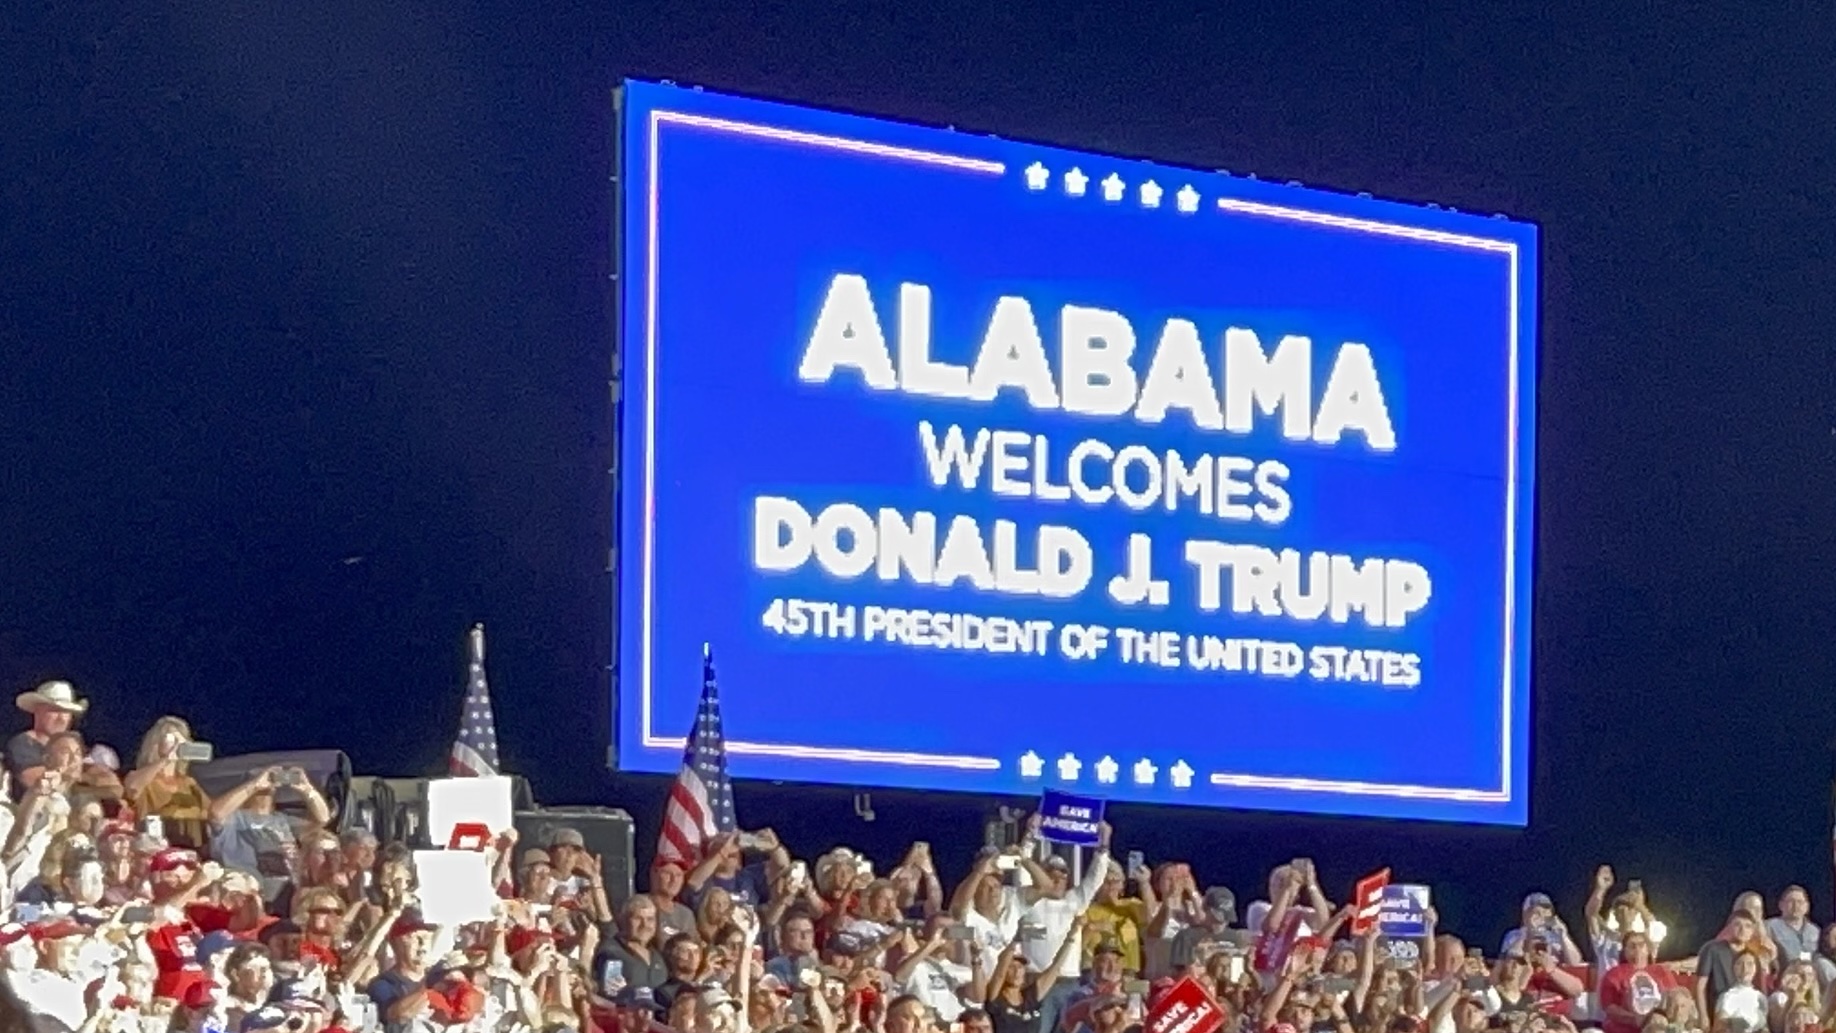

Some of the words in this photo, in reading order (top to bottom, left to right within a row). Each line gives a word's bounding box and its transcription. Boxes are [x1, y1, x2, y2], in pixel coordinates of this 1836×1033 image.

[798, 273, 1397, 452] ALABAMA
[918, 420, 1292, 524] WELCOMES
[753, 495, 1093, 599] DONALD
[1107, 532, 1170, 606] J.
[1184, 539, 1432, 628] TRUMP
[761, 598, 857, 638] 45TH
[862, 605, 1055, 657] PRESIDENT
[1059, 623, 1110, 660] OF
[1115, 627, 1181, 667] THE
[1185, 635, 1305, 678] UNITED
[1308, 645, 1421, 687] STATES
[1059, 804, 1091, 819] SAVE
[1153, 1001, 1189, 1033] SAVE
